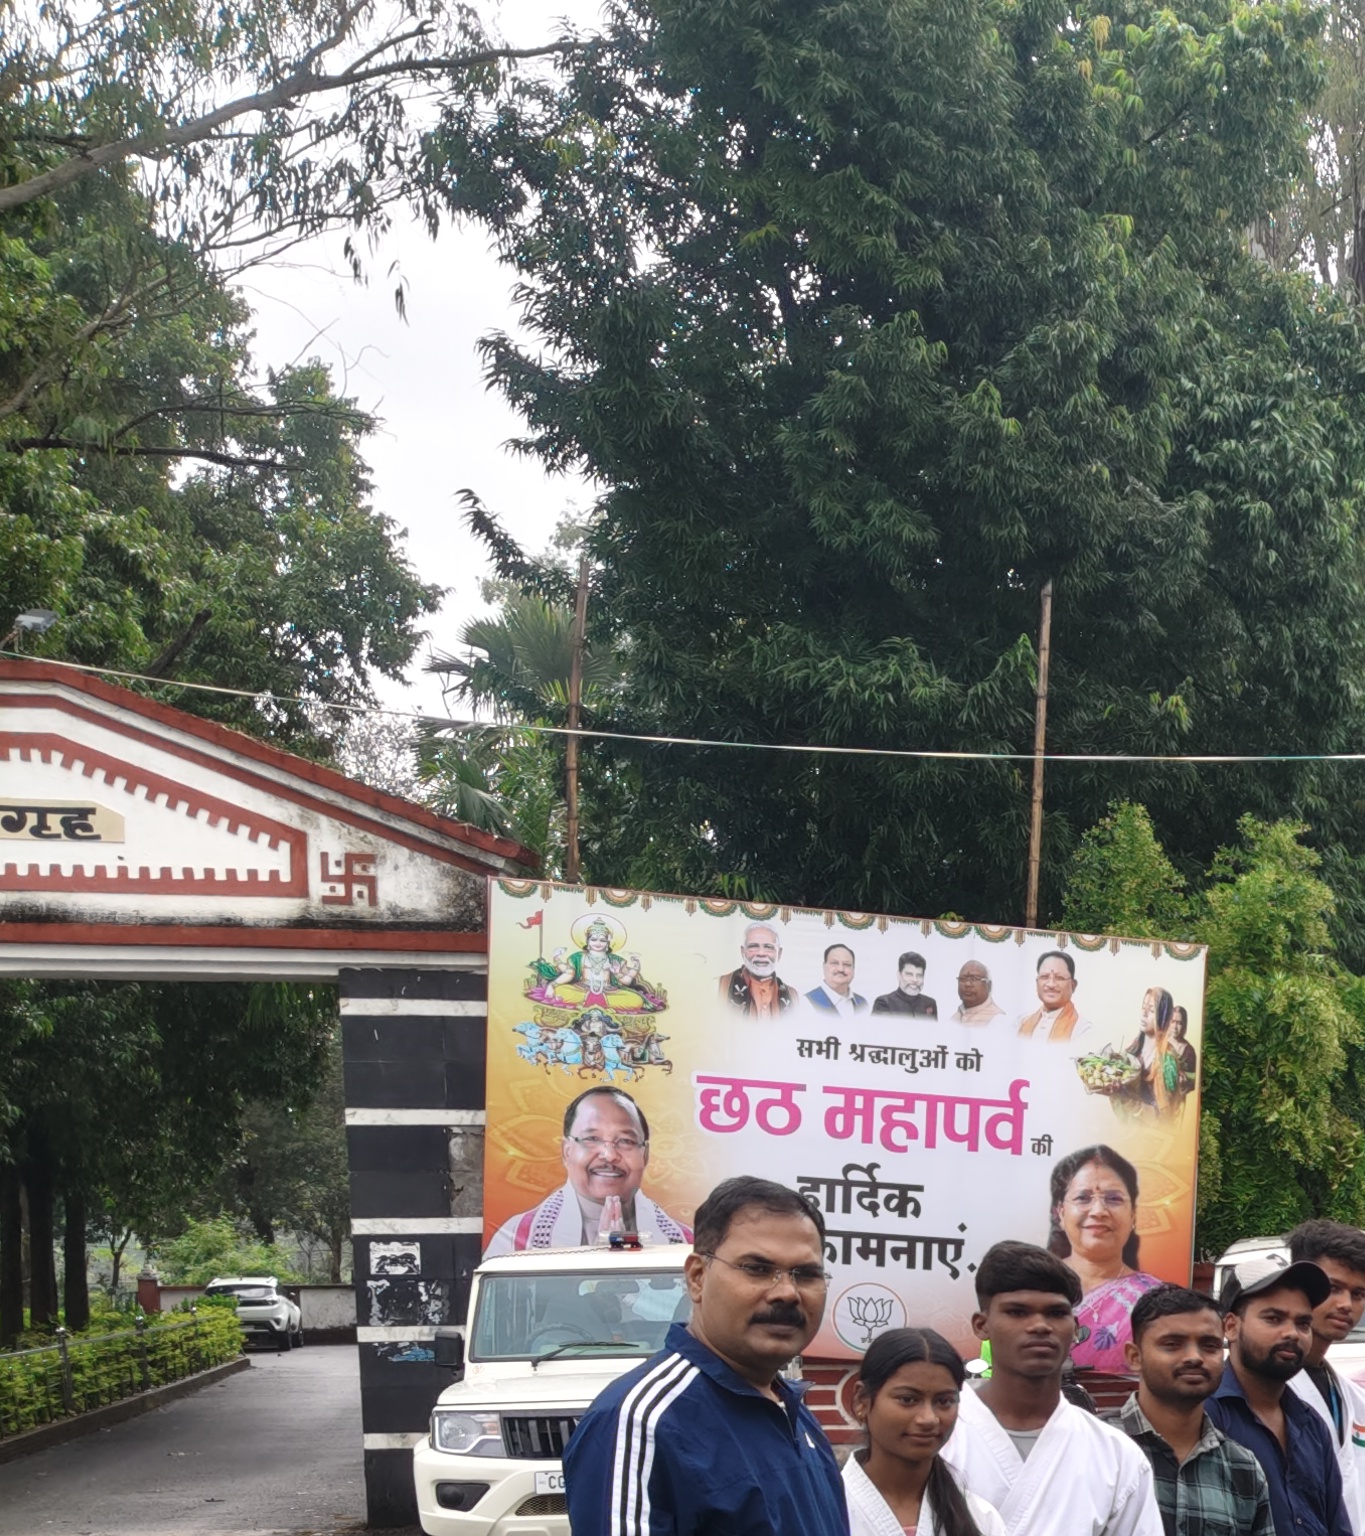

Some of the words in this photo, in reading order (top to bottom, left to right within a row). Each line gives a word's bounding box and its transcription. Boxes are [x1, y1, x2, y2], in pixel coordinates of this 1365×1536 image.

[796, 1036, 841, 1060] सभी
[849, 1043, 949, 1074] श्रद्धालुओं
[954, 1048, 984, 1072] को
[696, 1074, 807, 1135] छठ
[822, 1079, 1031, 1156] महापर्व
[1030, 1134, 1054, 1156] की
[797, 1162, 924, 1219] हार्दिक
